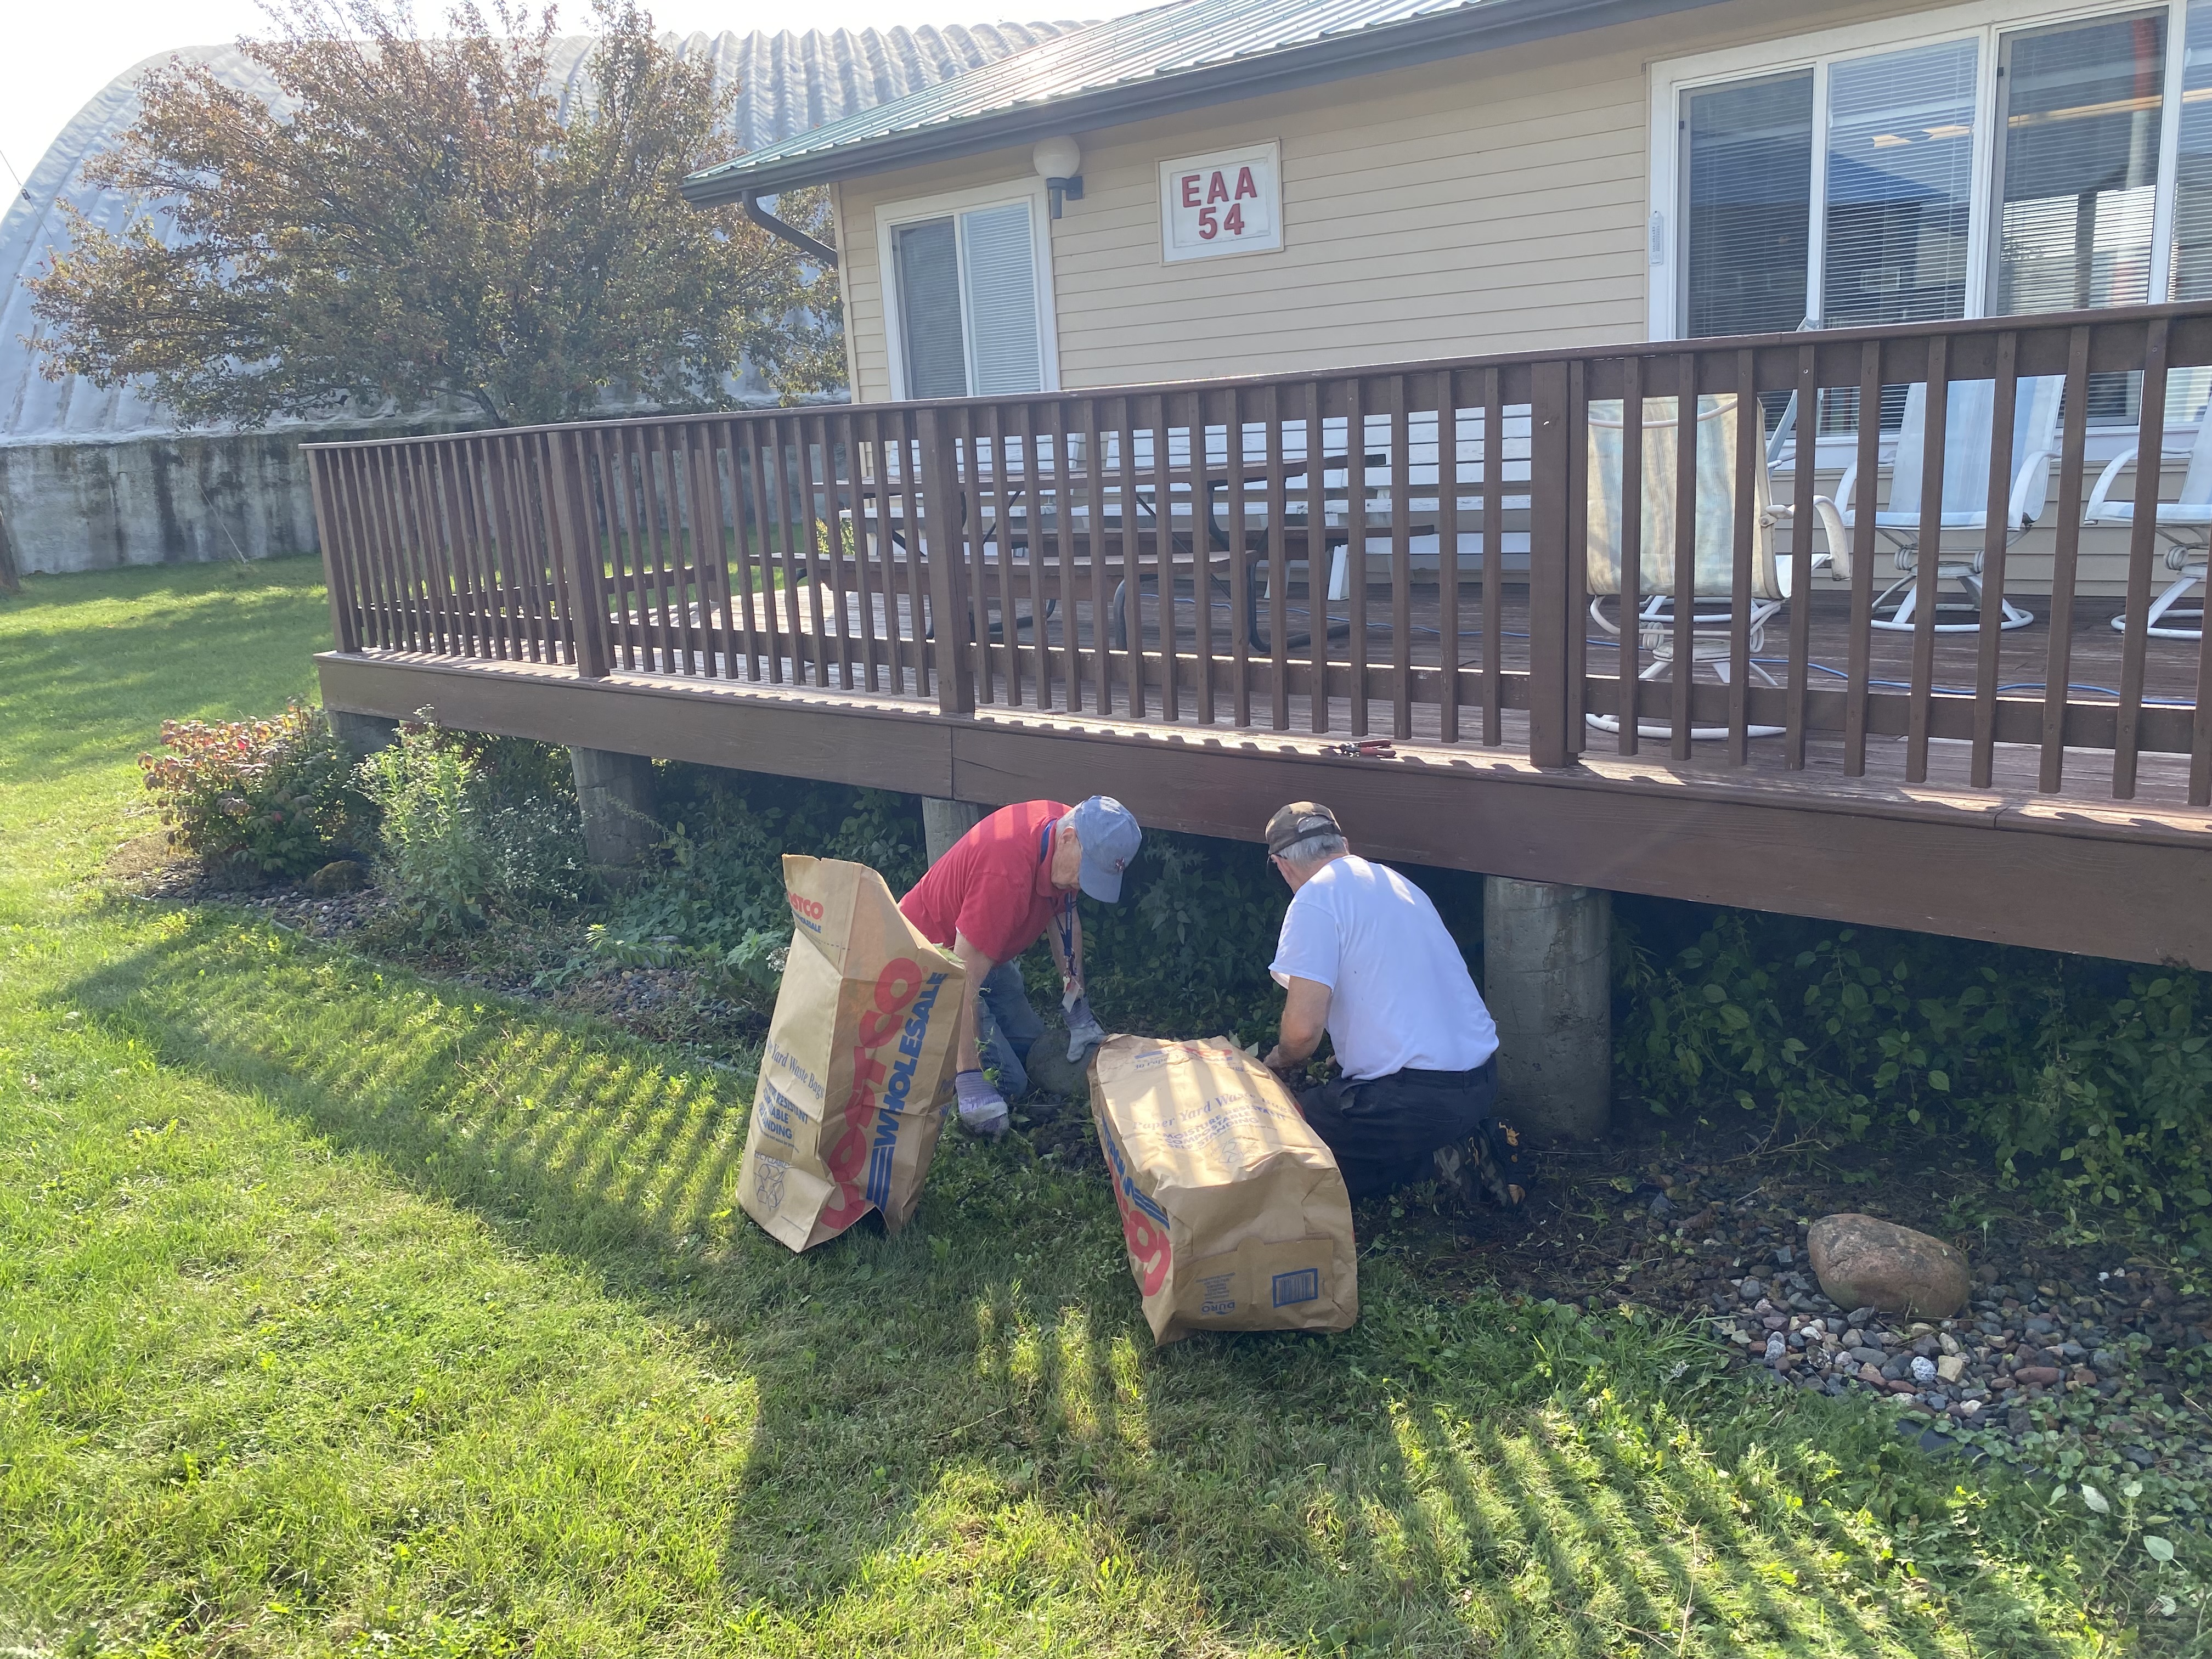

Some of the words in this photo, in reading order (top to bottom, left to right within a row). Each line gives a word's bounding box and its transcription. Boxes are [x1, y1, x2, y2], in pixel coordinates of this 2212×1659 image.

[1182, 166, 1257, 208] EAA
[1198, 203, 1245, 239] 54
[787, 889, 824, 920] STCO
[771, 1043, 789, 1068] Yard
[789, 1055, 809, 1084] Waste
[808, 1072, 825, 1099] Bags
[873, 972, 949, 1146] WHOLESALE
[776, 1091, 809, 1125] RESISTANT
[820, 957, 923, 1230] COSTCO
[1132, 1116, 1176, 1130] Paper
[1180, 1101, 1212, 1122] Yard
[1163, 1114, 1222, 1139] MOISTURE
[1165, 1111, 1252, 1145] COMPOSTABLE
[1197, 1116, 1260, 1148] STANDING
[1201, 1301, 1235, 1313] DURO
